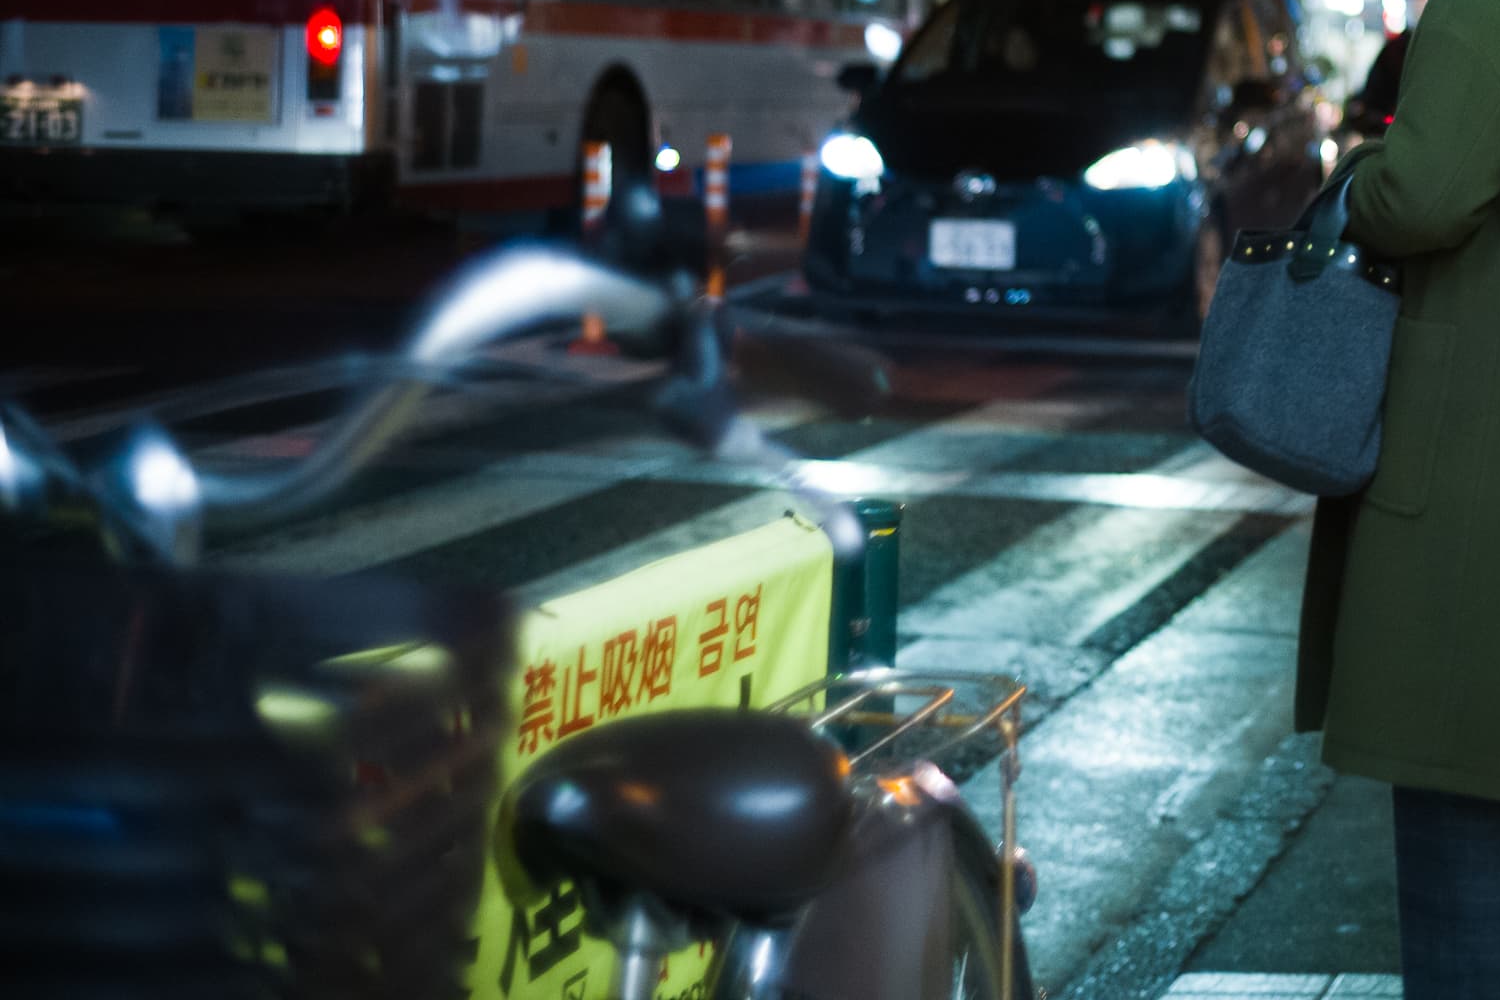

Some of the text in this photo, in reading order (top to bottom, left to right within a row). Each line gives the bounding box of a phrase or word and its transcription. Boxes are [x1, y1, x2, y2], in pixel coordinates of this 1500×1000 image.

[518, 582, 762, 756] 禁止吸烟 금연
